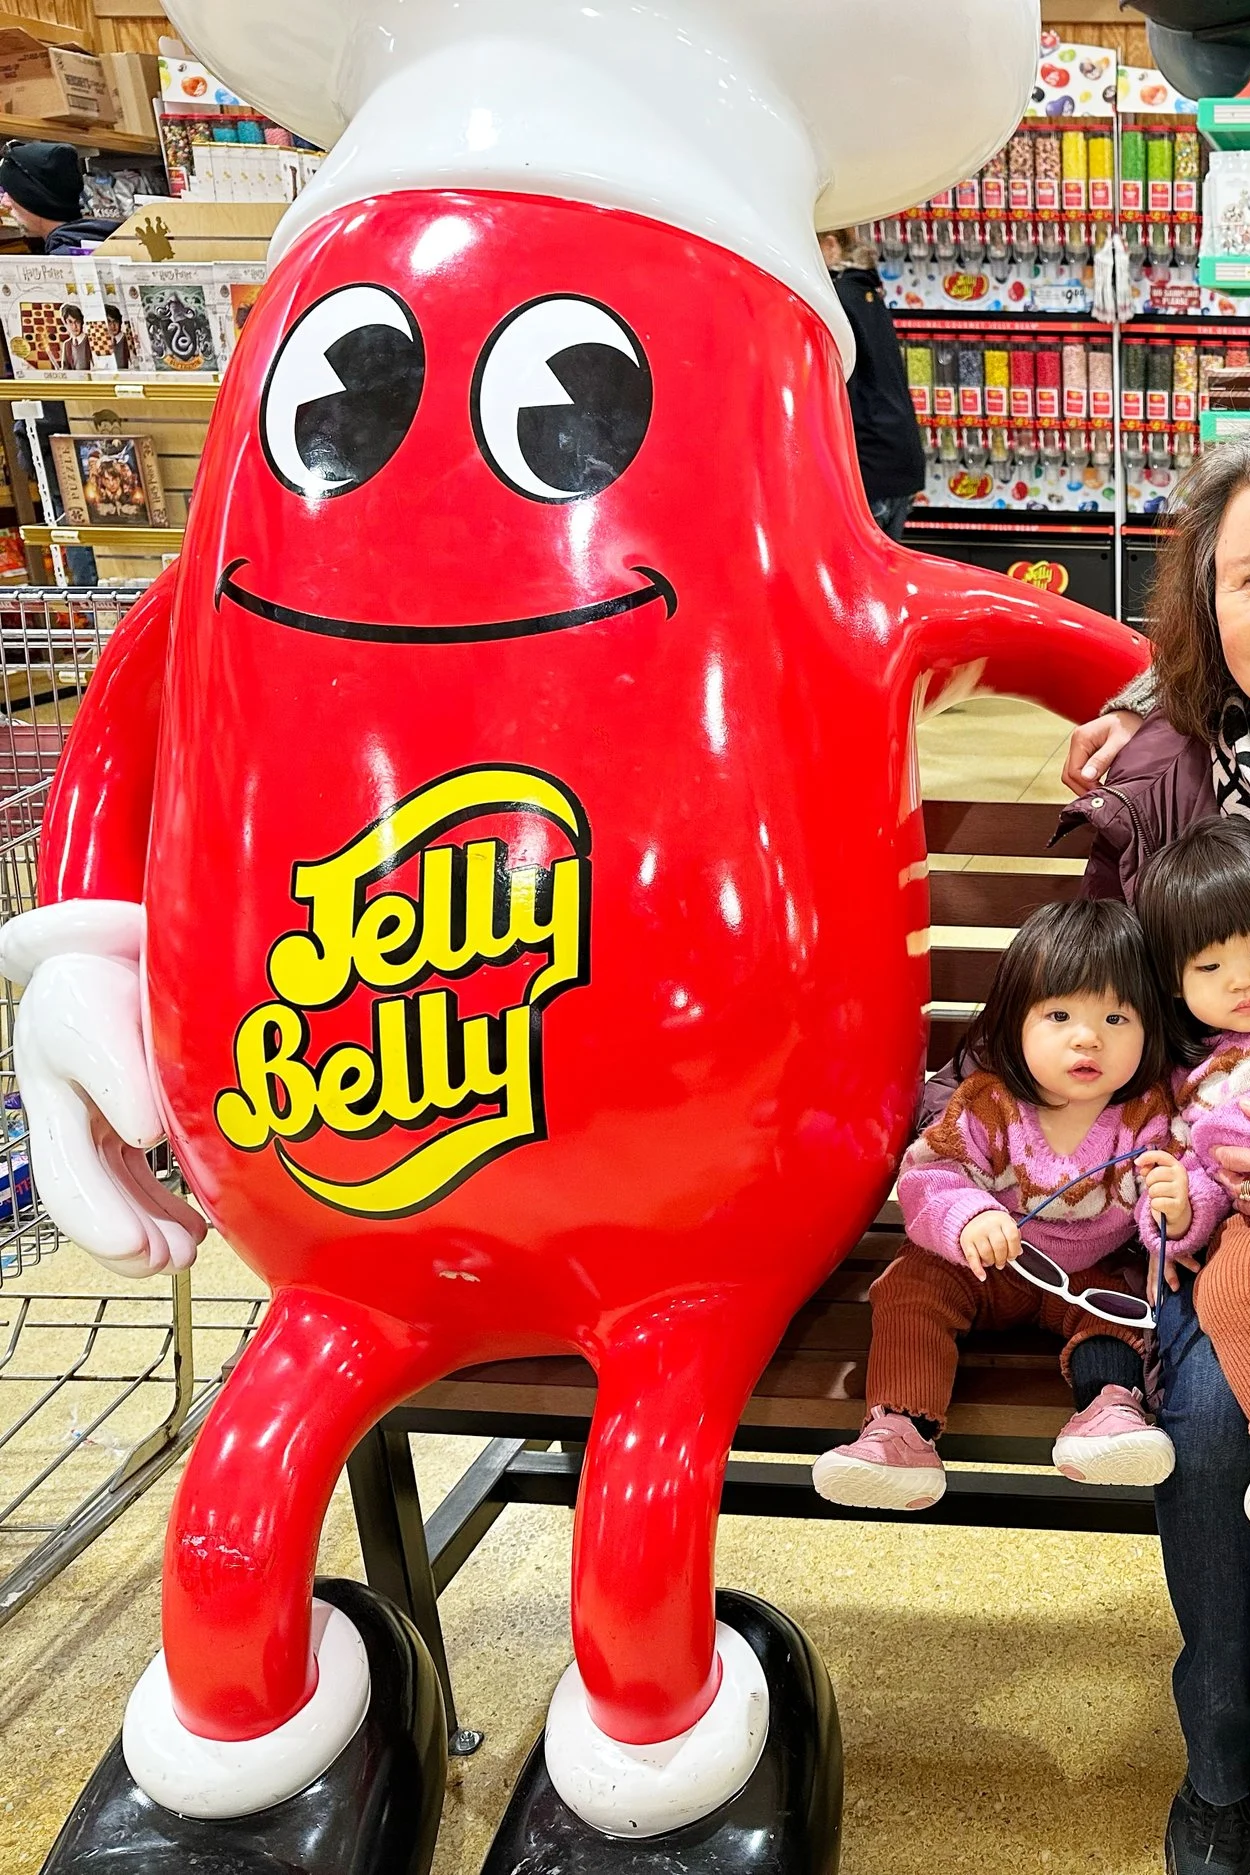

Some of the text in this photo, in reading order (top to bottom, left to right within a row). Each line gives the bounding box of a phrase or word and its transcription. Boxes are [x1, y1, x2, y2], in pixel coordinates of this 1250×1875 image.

[1024, 560, 1053, 582] Jelly
[268, 771, 580, 1006] Jelly
[214, 990, 538, 1200] Belly
